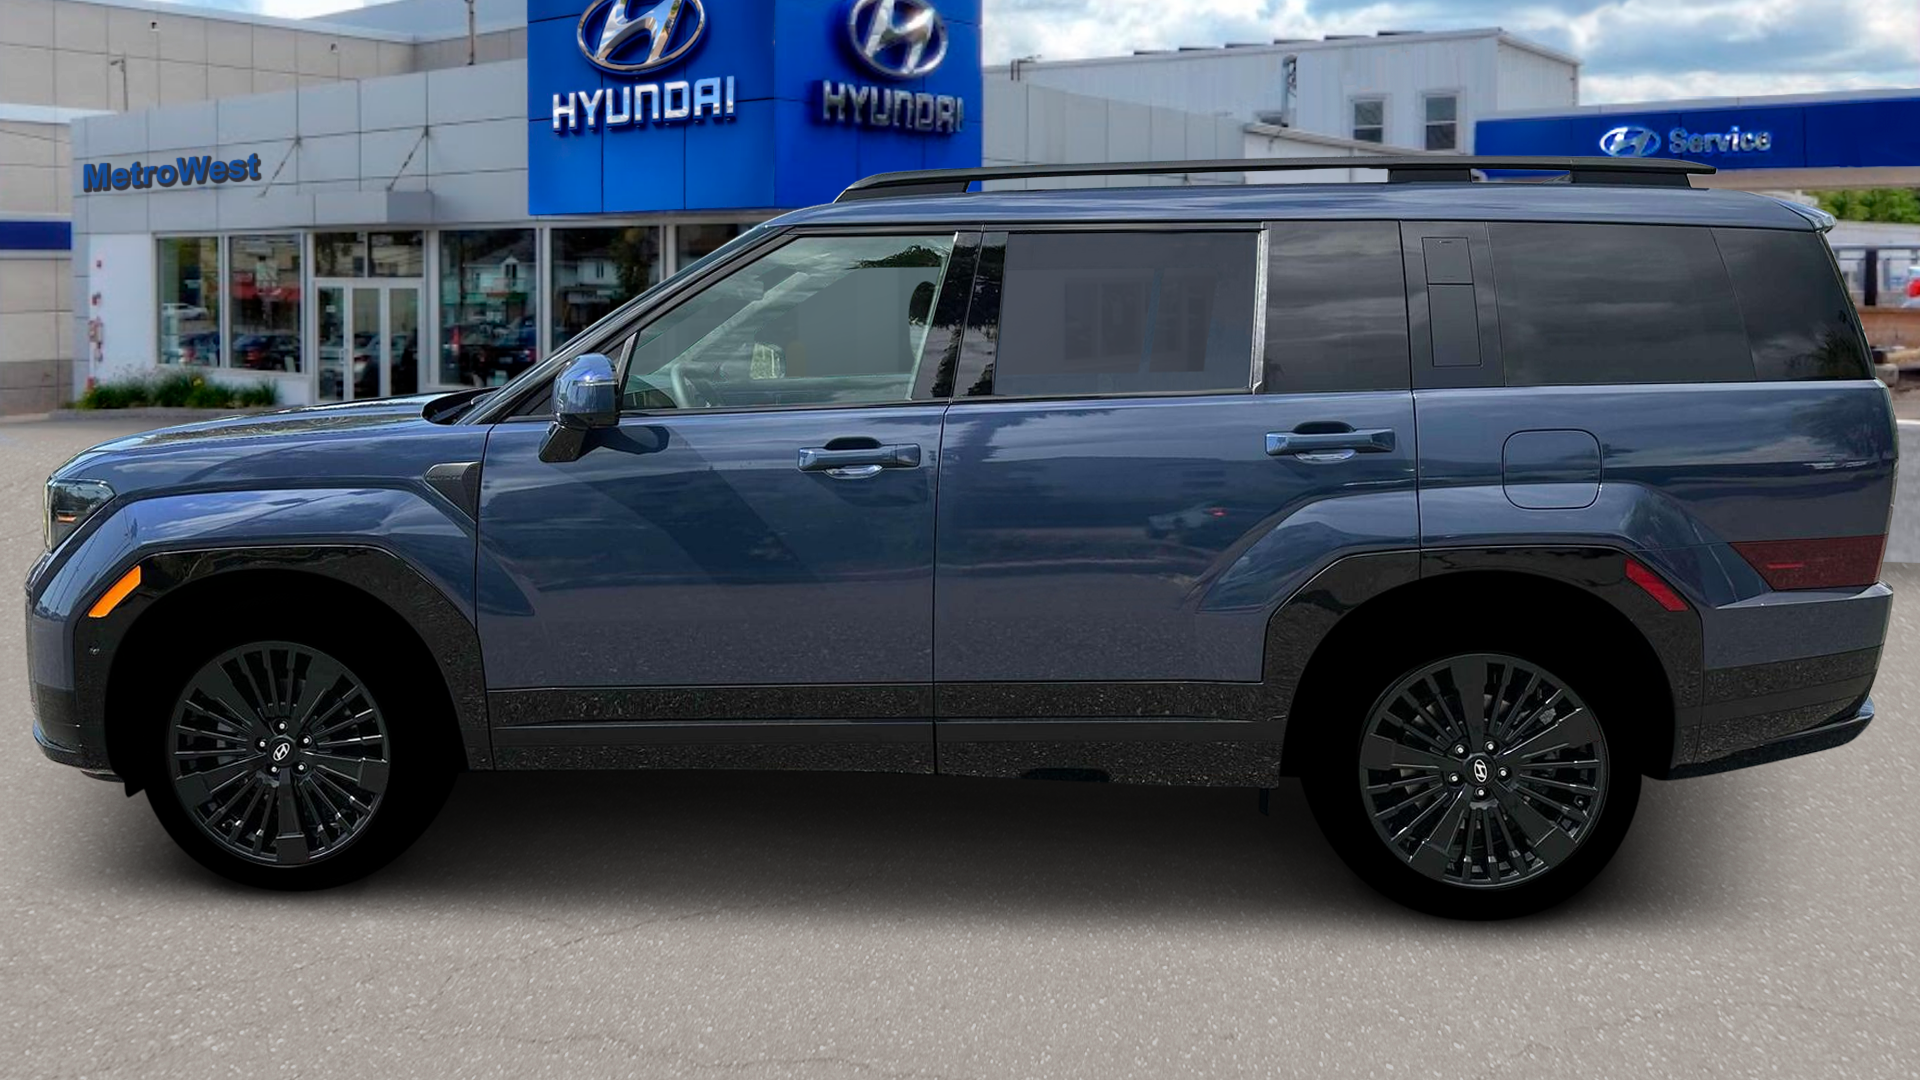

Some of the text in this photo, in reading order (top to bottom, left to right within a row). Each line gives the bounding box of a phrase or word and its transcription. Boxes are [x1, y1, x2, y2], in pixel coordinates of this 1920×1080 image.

[552, 75, 735, 131] HYUNDAI
[821, 80, 964, 133] HYUNDAI
[1669, 126, 1772, 153] Service
[83, 153, 262, 193] MetroWest
